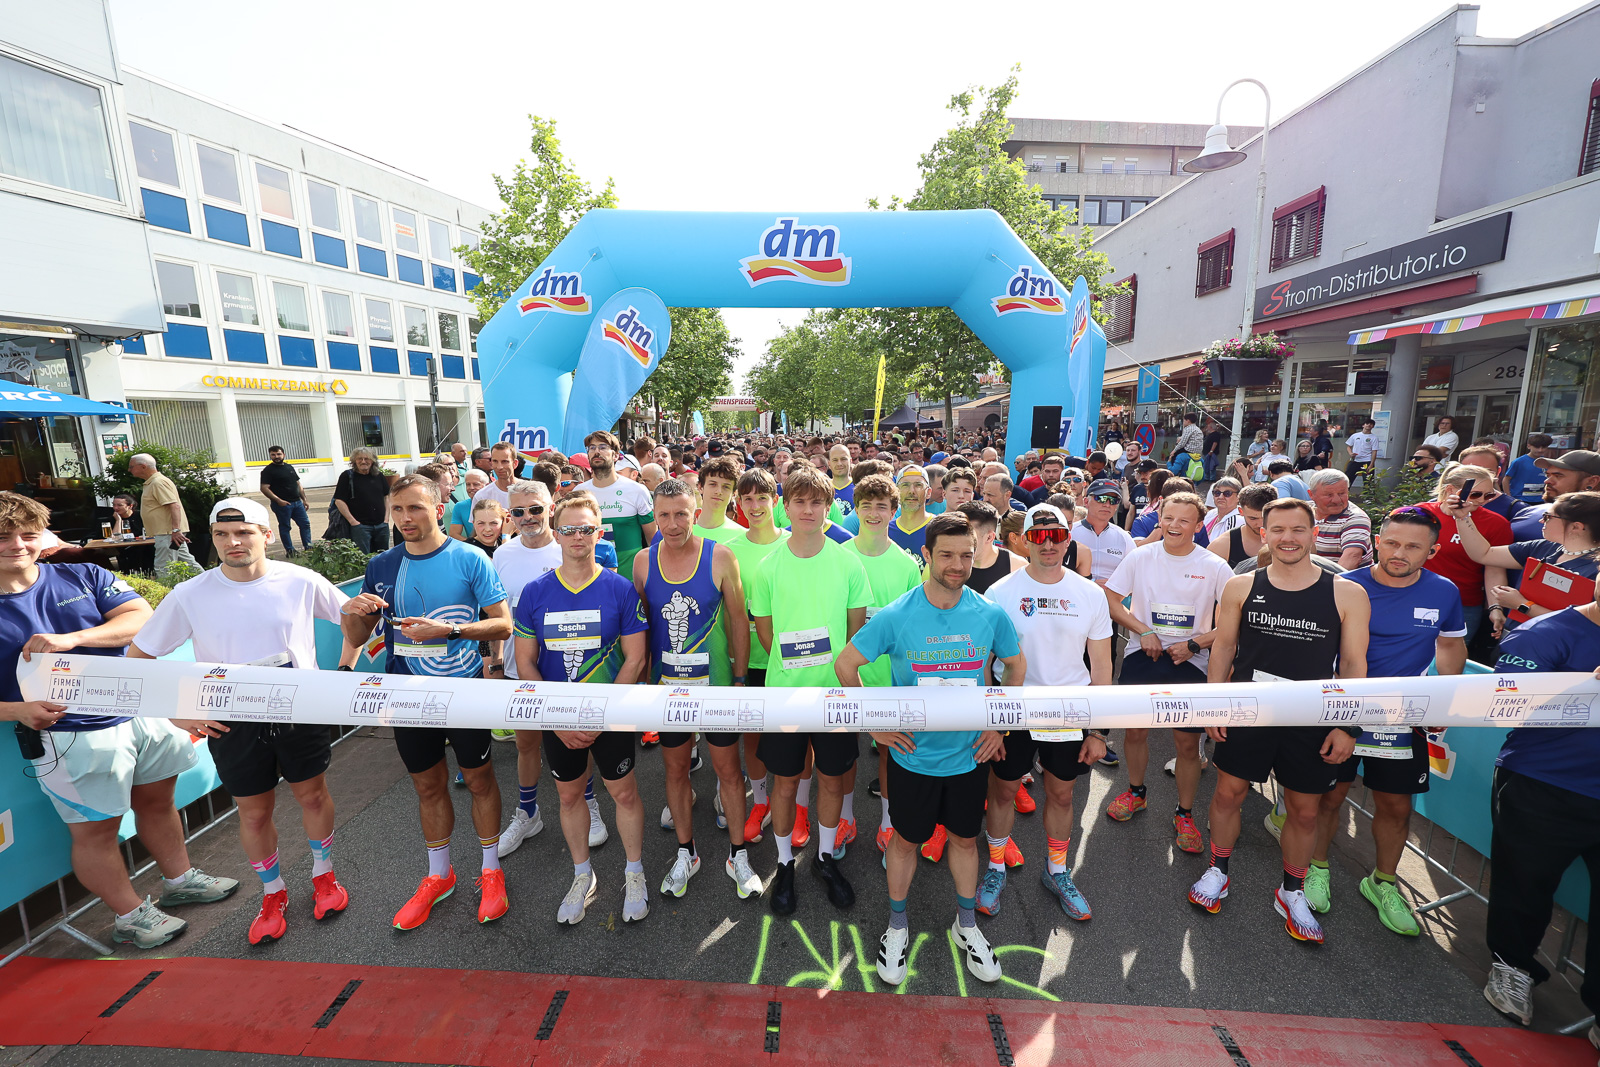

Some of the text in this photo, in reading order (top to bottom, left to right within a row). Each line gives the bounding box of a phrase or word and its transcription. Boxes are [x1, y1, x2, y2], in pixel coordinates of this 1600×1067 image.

[764, 220, 836, 258] dm
[532, 268, 578, 296] dm
[1010, 268, 1054, 296] dm
[1262, 244, 1466, 316] Strom-Distributor.io
[223, 292, 252, 302] Kranken-
[223, 302, 256, 311] gymnastik
[616, 308, 652, 348] dm
[202, 374, 329, 392] COMMERZBANK
[1142, 371, 1154, 398] P
[501, 422, 546, 450] dm
[1156, 613, 1188, 622] Christoph
[1248, 612, 1317, 632] IT-Diplomaten
[558, 623, 586, 632] Sascha
[794, 642, 815, 650] Jonas
[906, 643, 987, 660] ELEKTROLÜTE
[54, 658, 70, 667] dm
[53, 678, 81, 687] FIRMEN
[1498, 678, 1516, 687] dm
[51, 688, 80, 700] LAUF
[202, 685, 232, 694] FIRMEN
[200, 696, 230, 708] LAUF
[356, 692, 388, 700] FIRMEN
[512, 697, 544, 705] FIRMEN
[353, 701, 384, 714] LAUF
[1156, 701, 1189, 710] FIRMEN
[1327, 700, 1360, 709] FIRMEN
[509, 706, 540, 718] LAUF
[667, 710, 699, 722] LAUF
[828, 712, 859, 724] LAUF
[991, 712, 1022, 724] LAUF
[1156, 712, 1189, 723] LAUF
[1324, 710, 1358, 721] LAUF
[1490, 707, 1523, 717] LAUF
